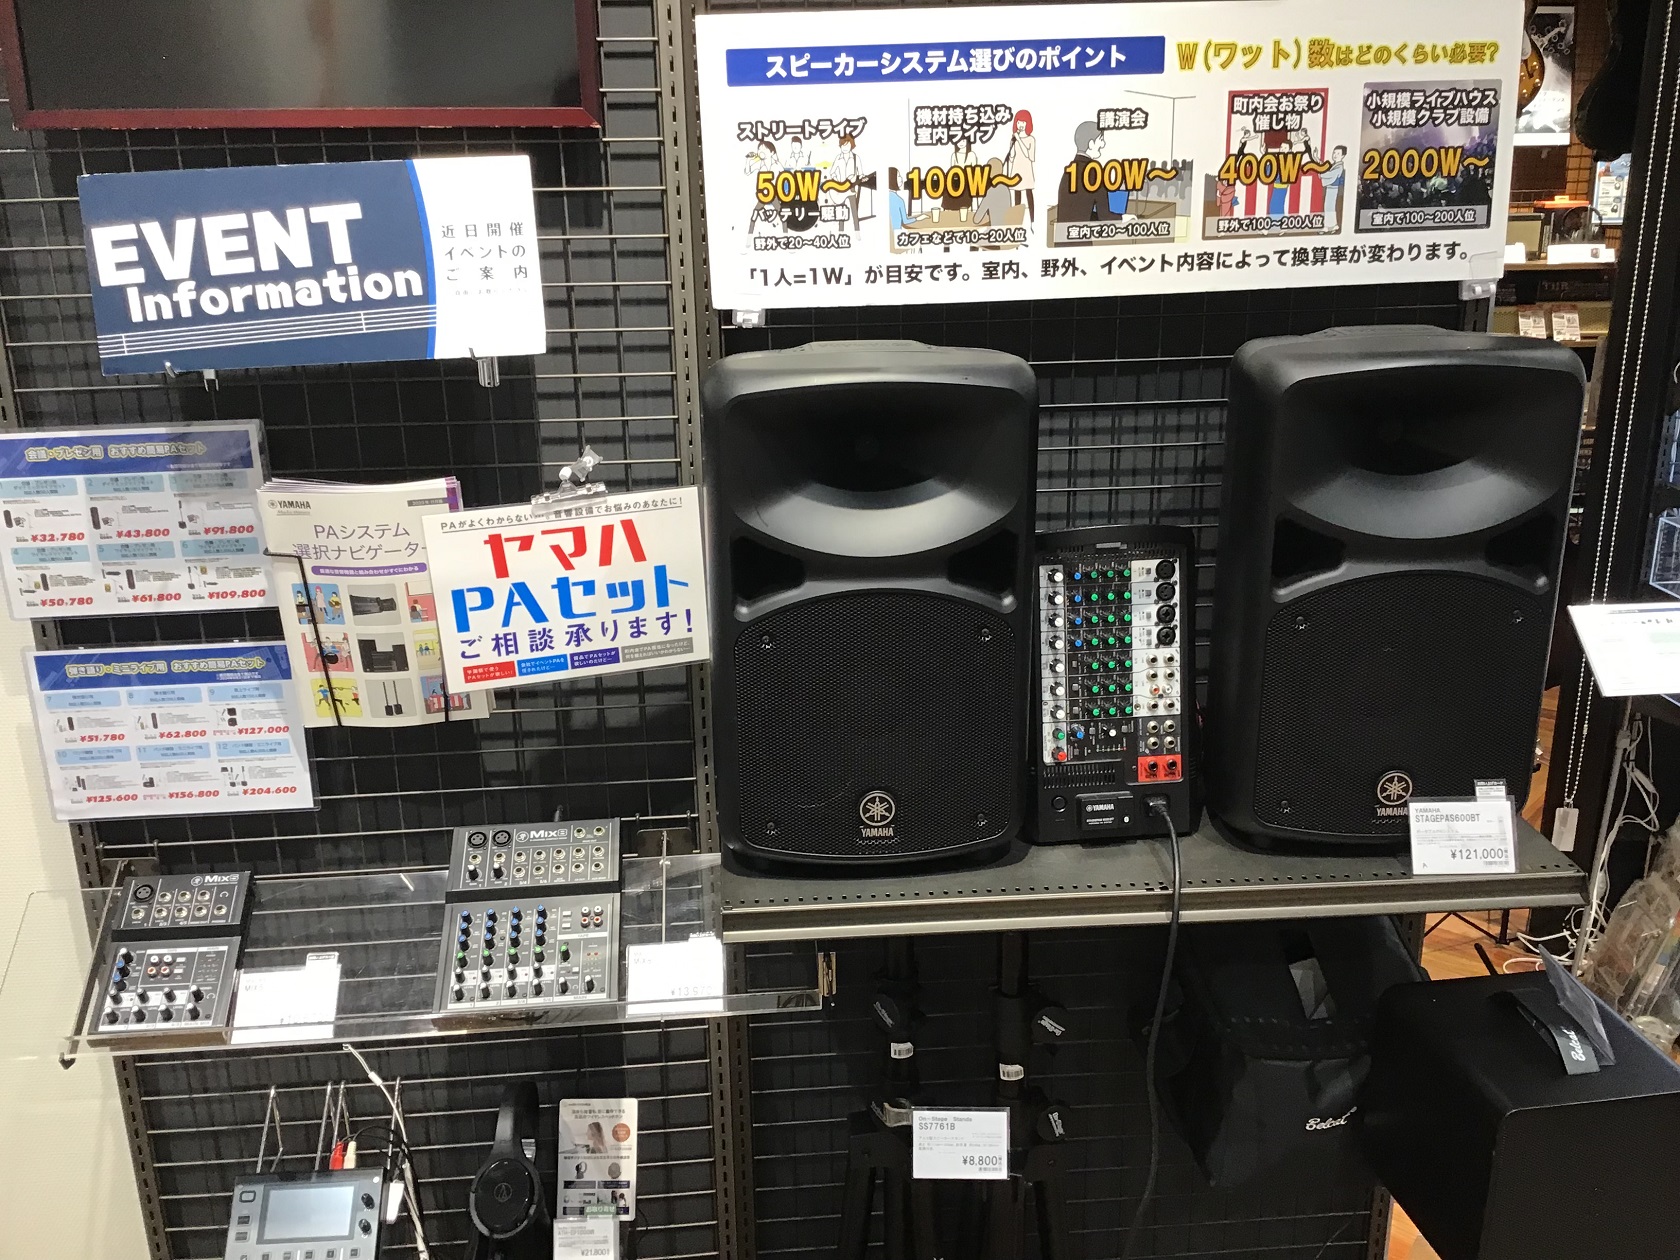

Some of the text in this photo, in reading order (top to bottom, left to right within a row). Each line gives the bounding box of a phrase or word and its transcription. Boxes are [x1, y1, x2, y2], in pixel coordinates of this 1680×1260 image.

[766, 46, 1127, 78] スピーカーシステム選びのポイント
[1176, 36, 1500, 71] W(ワット)数はどのくらい必要?
[1233, 94, 1324, 114] 町内会お祭り
[1366, 89, 1497, 109] 小規模ライブハウス
[915, 104, 1012, 126] 機材持ち込み
[1098, 108, 1148, 130] 講演会
[1372, 107, 1490, 127] 小規模クラブ設備
[737, 116, 867, 142] ストリートライブ
[915, 125, 998, 145] 室内ライブ
[751, 205, 850, 222] バッテリー駆動
[1371, 209, 1476, 225] 室内で100~200人位
[441, 221, 525, 239] 近日開催
[1067, 221, 1170, 239] 室内で20~100人位
[1217, 214, 1325, 233] 野外で100~200人位
[91, 202, 363, 288] EVENT
[753, 234, 851, 251] 野外で20~40人位
[898, 228, 1026, 247] カフェなどで10~20人位
[444, 244, 526, 261] イベントの
[446, 264, 529, 281] ご案内
[126, 265, 424, 324] Information
[277, 500, 312, 510] YAMAHA
[31, 533, 85, 543] ¥32,780
[116, 529, 170, 540] ¥43,800
[203, 525, 255, 536] ¥91,800
[313, 522, 411, 540] PAシステム
[483, 518, 648, 579] ヤマハ
[40, 597, 94, 607] ¥50,780
[132, 593, 182, 603] ¥61,800
[207, 589, 266, 600] ¥109,800
[451, 564, 689, 634] PAセット
[460, 608, 694, 660] ご相談承ります!
[79, 733, 126, 743] ¥51,780
[158, 729, 207, 739] ¥62,800
[237, 725, 290, 735] ¥127,000
[86, 793, 139, 803] ¥125,600
[242, 785, 298, 796] ¥204,600
[1092, 803, 1115, 812] YAMAHA
[1376, 806, 1409, 817] YAMAHA
[1415, 813, 1480, 823] STAGEPAS600BT
[530, 829, 568, 838] Mix8
[861, 827, 894, 838] YAMAHA
[918, 1122, 956, 1131] SS7761B
[1305, 1106, 1358, 1131] Belcat
[962, 1155, 998, 1166] ¥8,800
